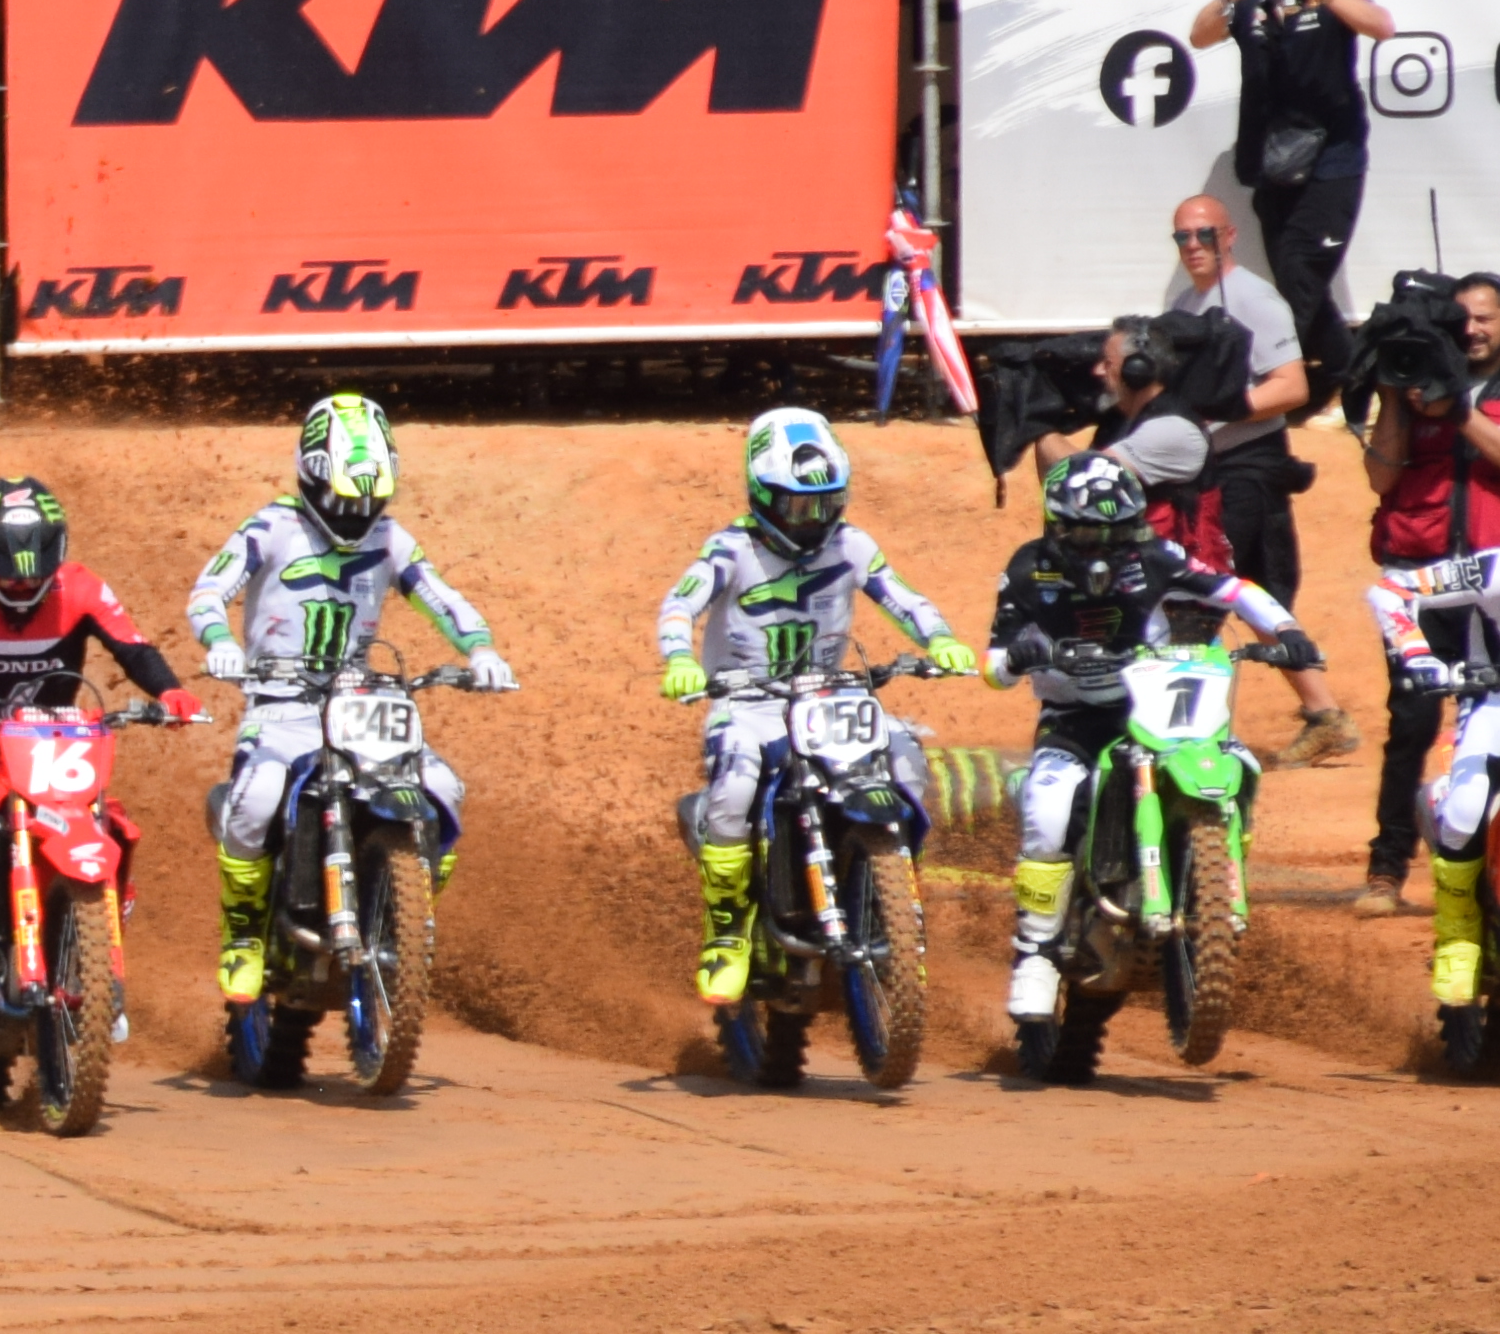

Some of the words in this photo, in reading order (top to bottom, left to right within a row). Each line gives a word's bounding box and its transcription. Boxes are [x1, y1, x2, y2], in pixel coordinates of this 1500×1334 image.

[28, 264, 185, 319] KTM
[261, 259, 422, 313] KTM
[496, 255, 657, 309] KTM
[731, 251, 886, 305] KTM
[340, 701, 412, 745] 243
[1165, 676, 1208, 730] 1
[28, 739, 97, 796] 16
